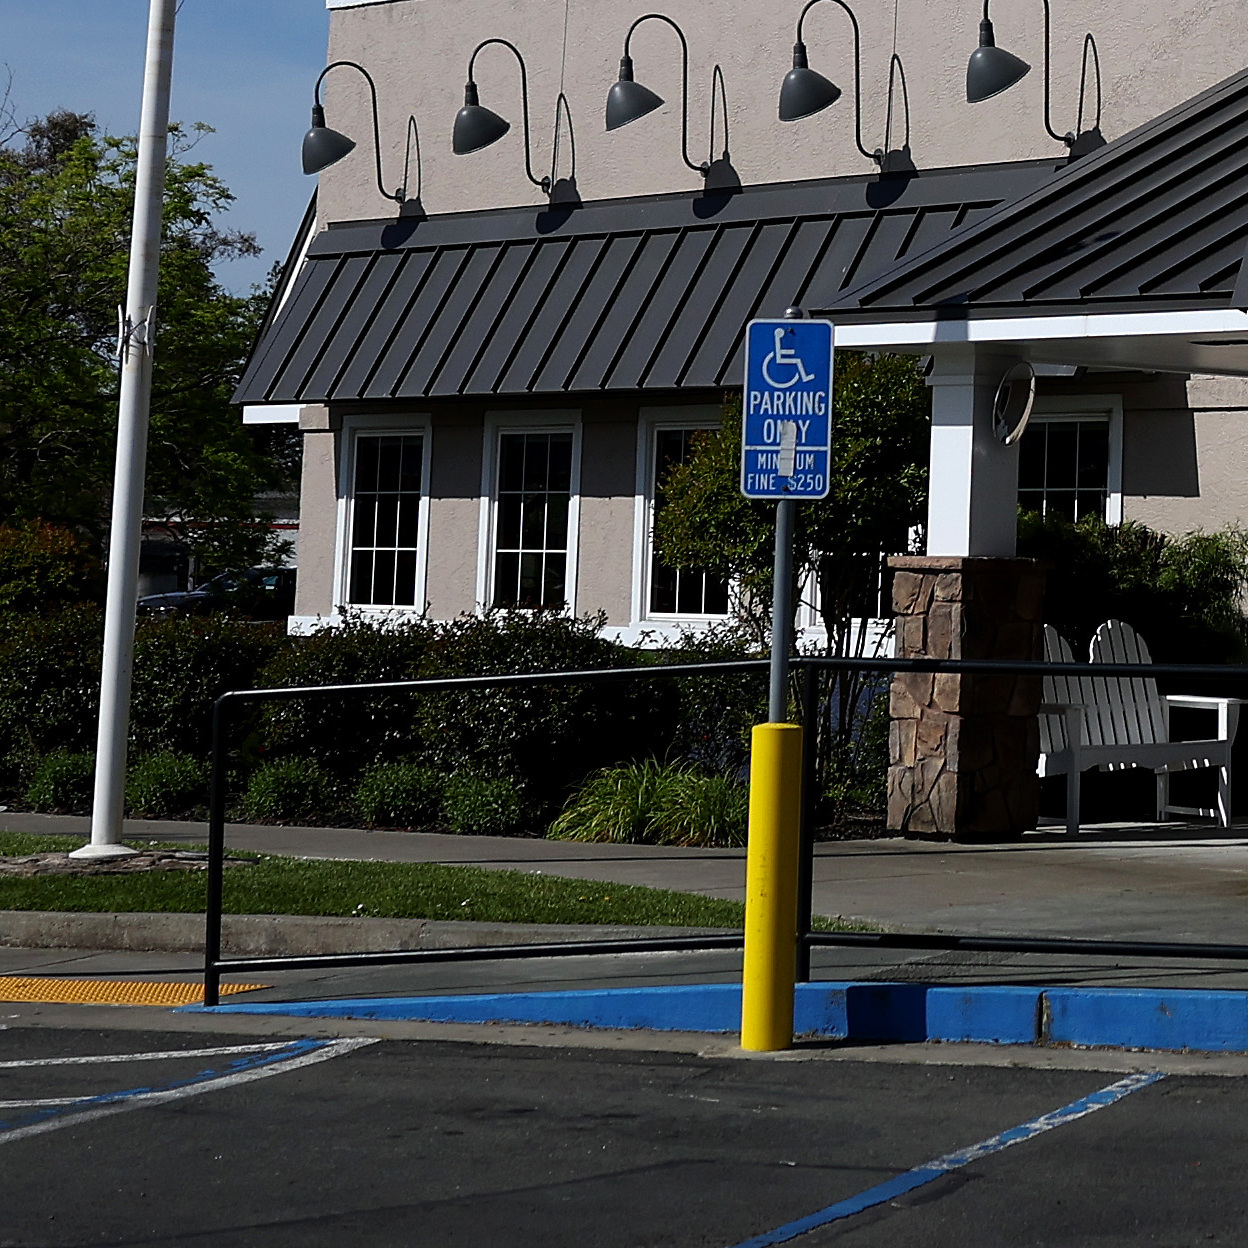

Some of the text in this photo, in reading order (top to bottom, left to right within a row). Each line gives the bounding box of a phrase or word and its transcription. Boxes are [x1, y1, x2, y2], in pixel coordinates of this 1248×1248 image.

[750, 390, 826, 416] PARKING
[763, 418, 811, 444] ONY
[757, 453, 815, 470] MINUM
[747, 473, 824, 491] FINE $250
